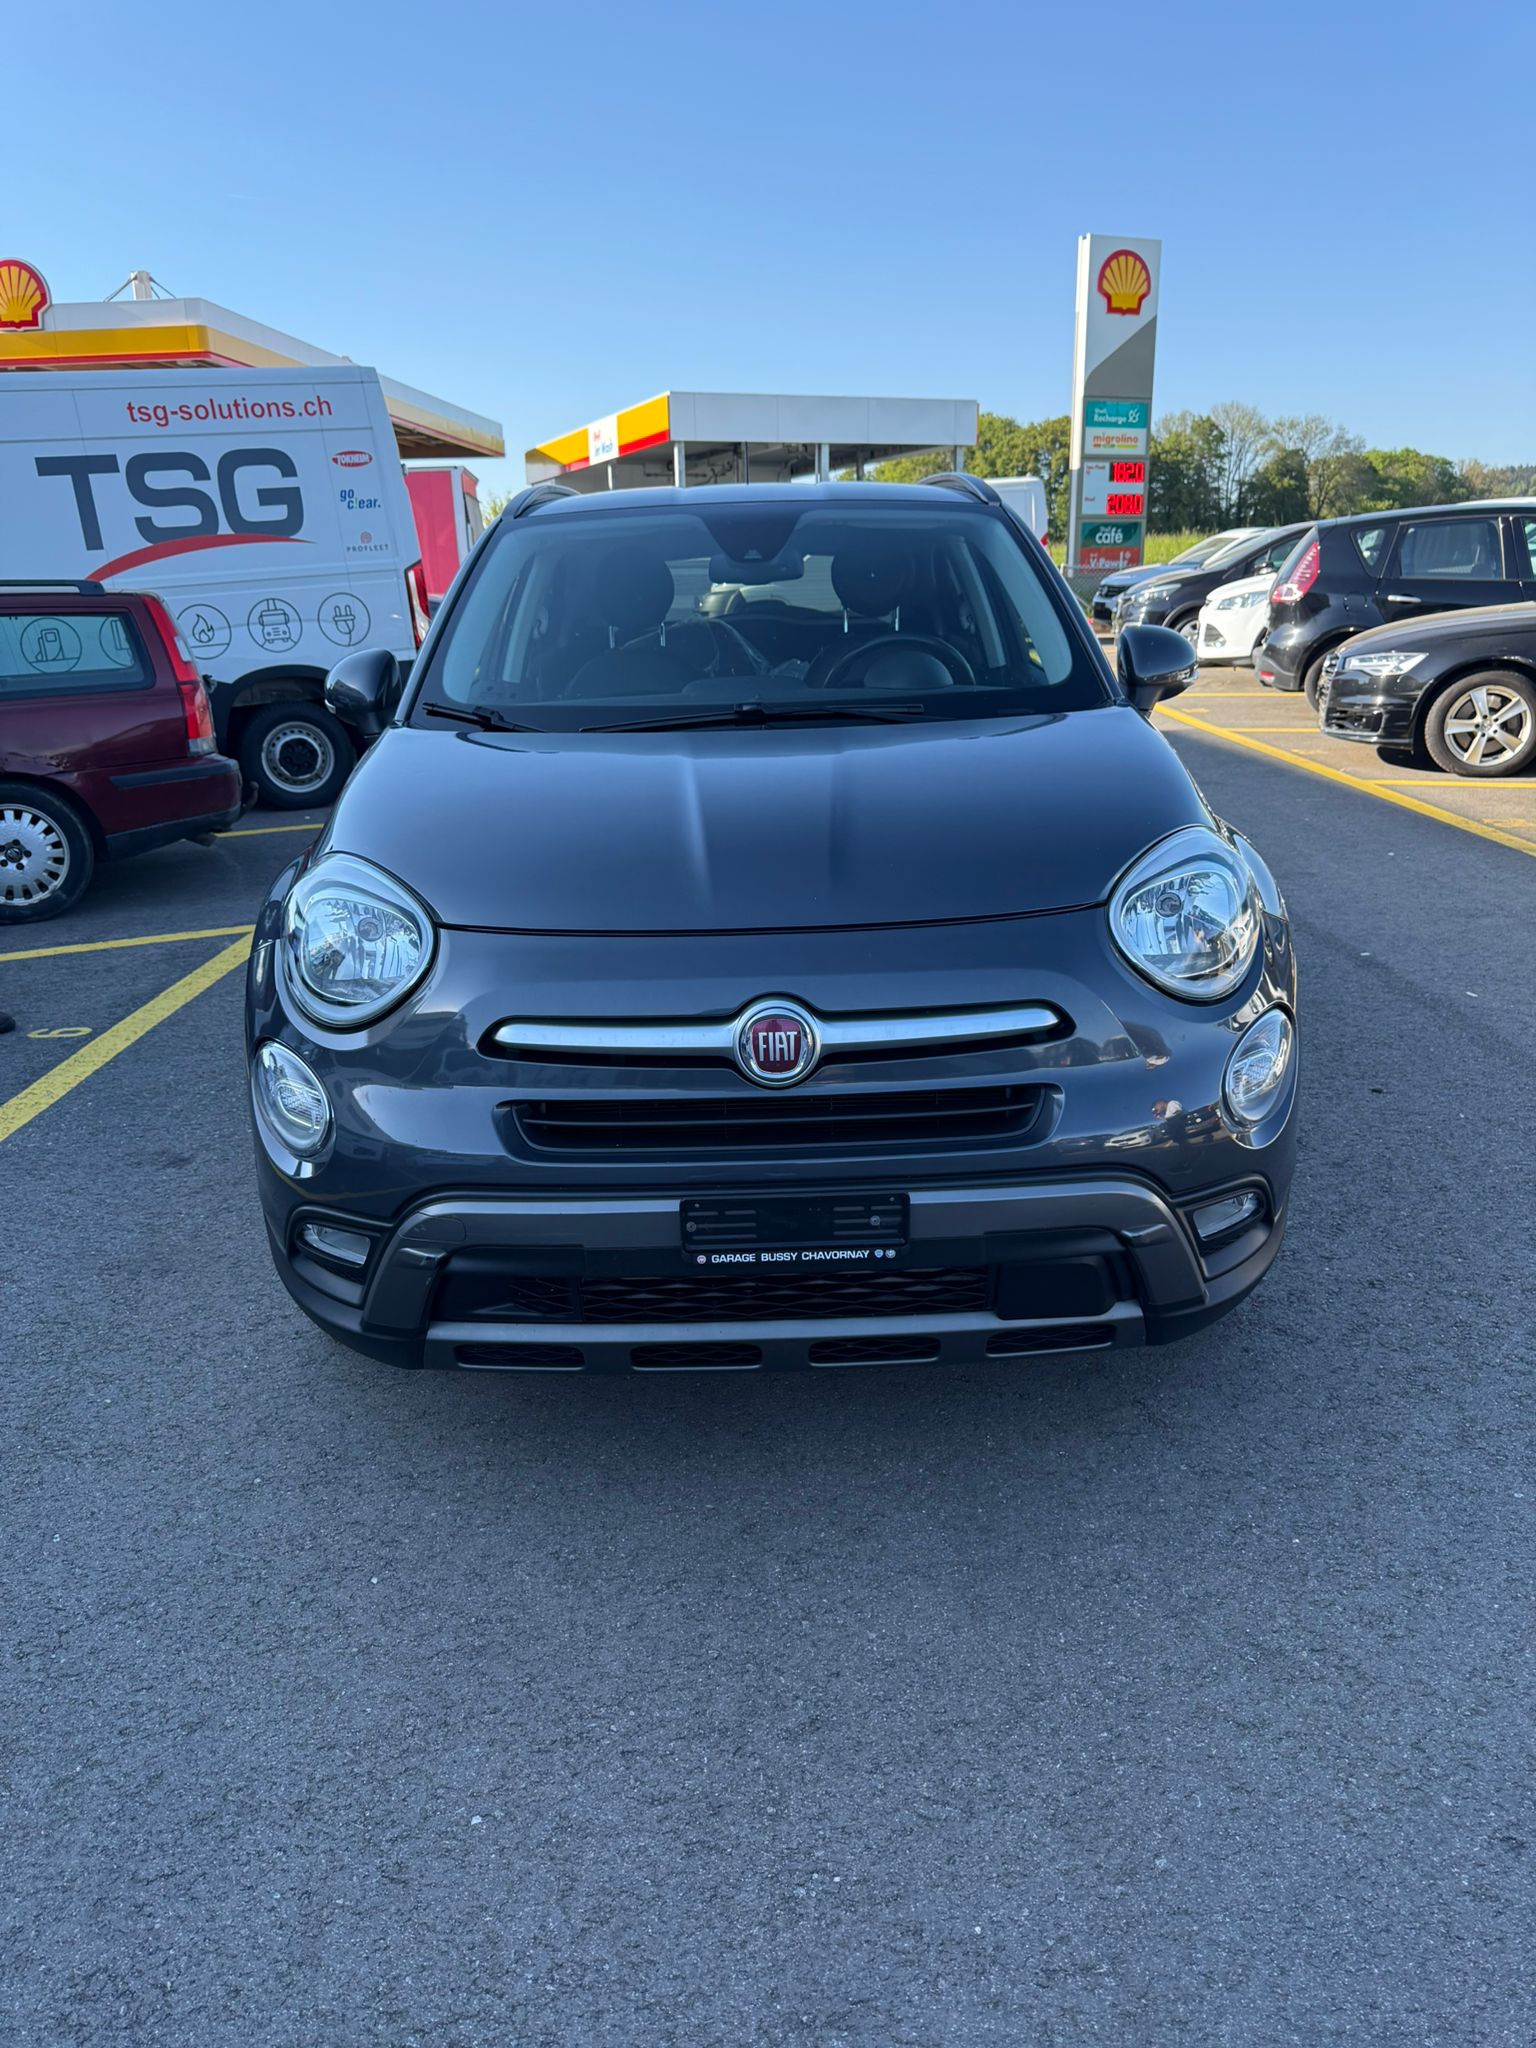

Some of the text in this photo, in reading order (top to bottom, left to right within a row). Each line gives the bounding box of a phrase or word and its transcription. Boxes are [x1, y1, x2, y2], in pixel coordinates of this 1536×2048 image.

[127, 395, 333, 427] tsg-solutions.ch
[1094, 413, 1127, 424] Recharge
[1093, 433, 1138, 445] migrolino
[34, 447, 305, 552] TSG
[340, 488, 354, 502] go
[1095, 527, 1124, 544] café
[346, 543, 389, 553] PROFLEET
[758, 1031, 798, 1062] FIAT
[711, 1249, 870, 1264] GARAGE BUSSY CHAVORNAY
